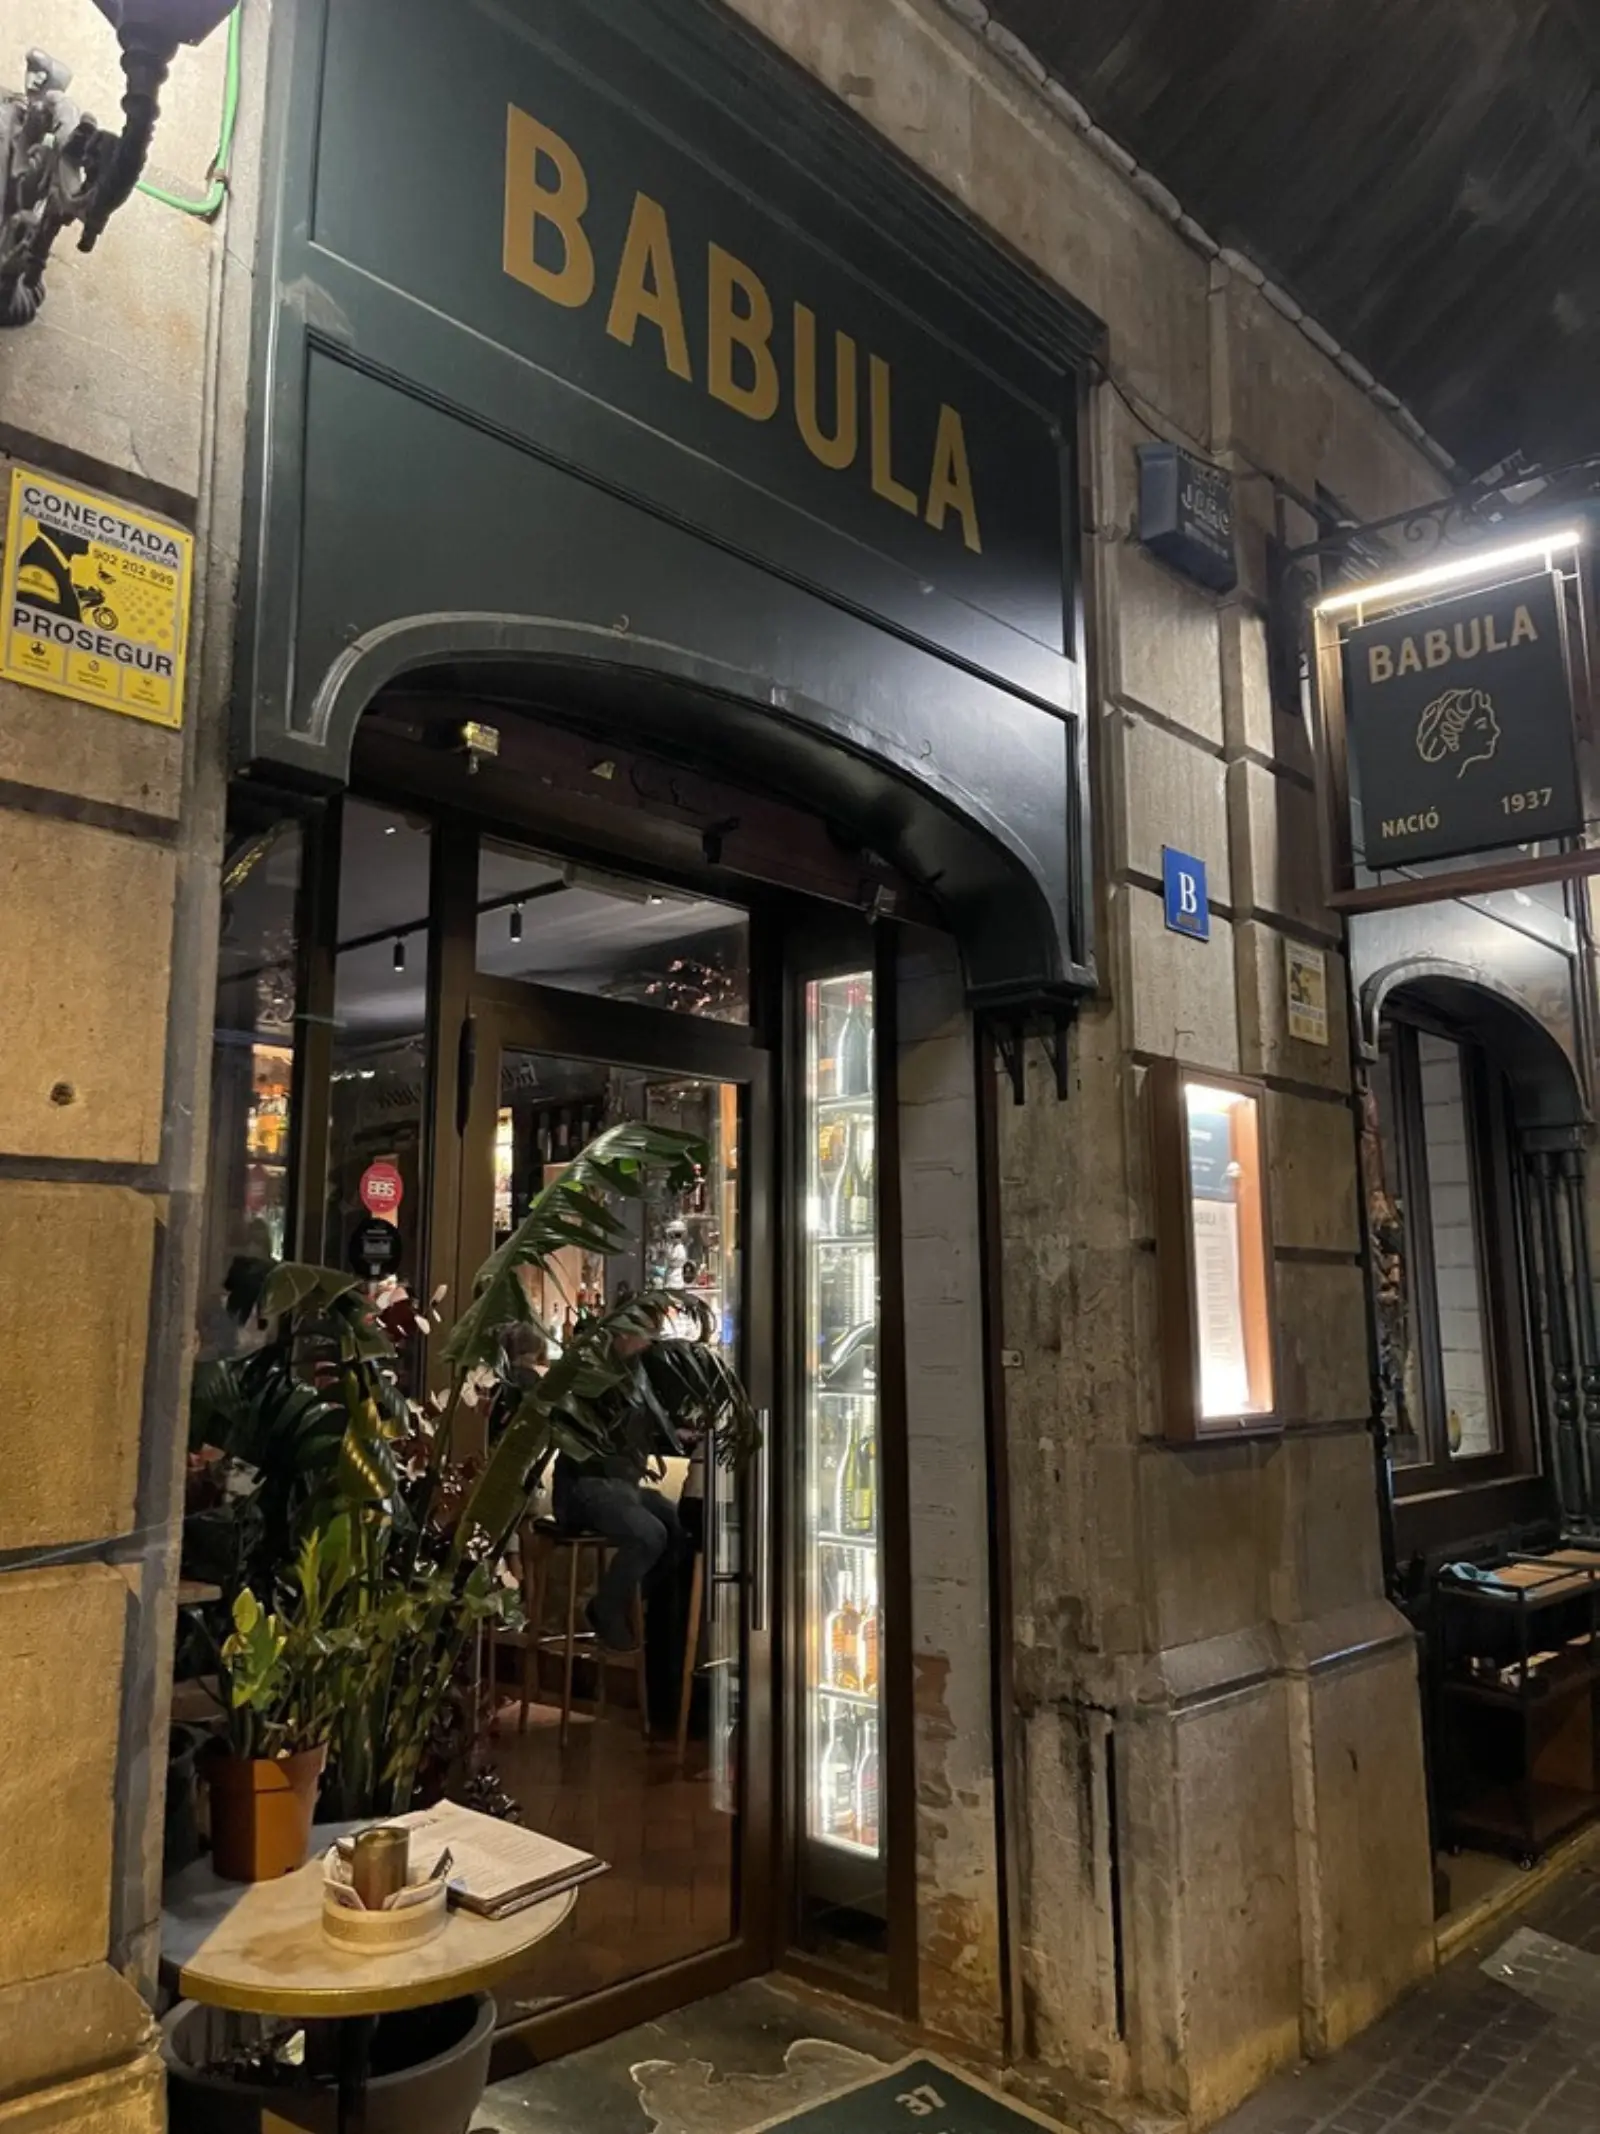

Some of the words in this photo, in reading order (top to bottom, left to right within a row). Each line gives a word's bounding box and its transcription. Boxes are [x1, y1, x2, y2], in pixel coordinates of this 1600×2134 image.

[503, 102, 982, 555] BABULA
[23, 486, 180, 559] CONECTADA
[122, 558, 147, 577] 202
[13, 606, 174, 678] PROSEGUR
[1368, 604, 1539, 684] BABULA
[1381, 806, 1440, 839] NACIÓ
[1501, 787, 1553, 815] 1937
[1178, 871, 1198, 914] B
